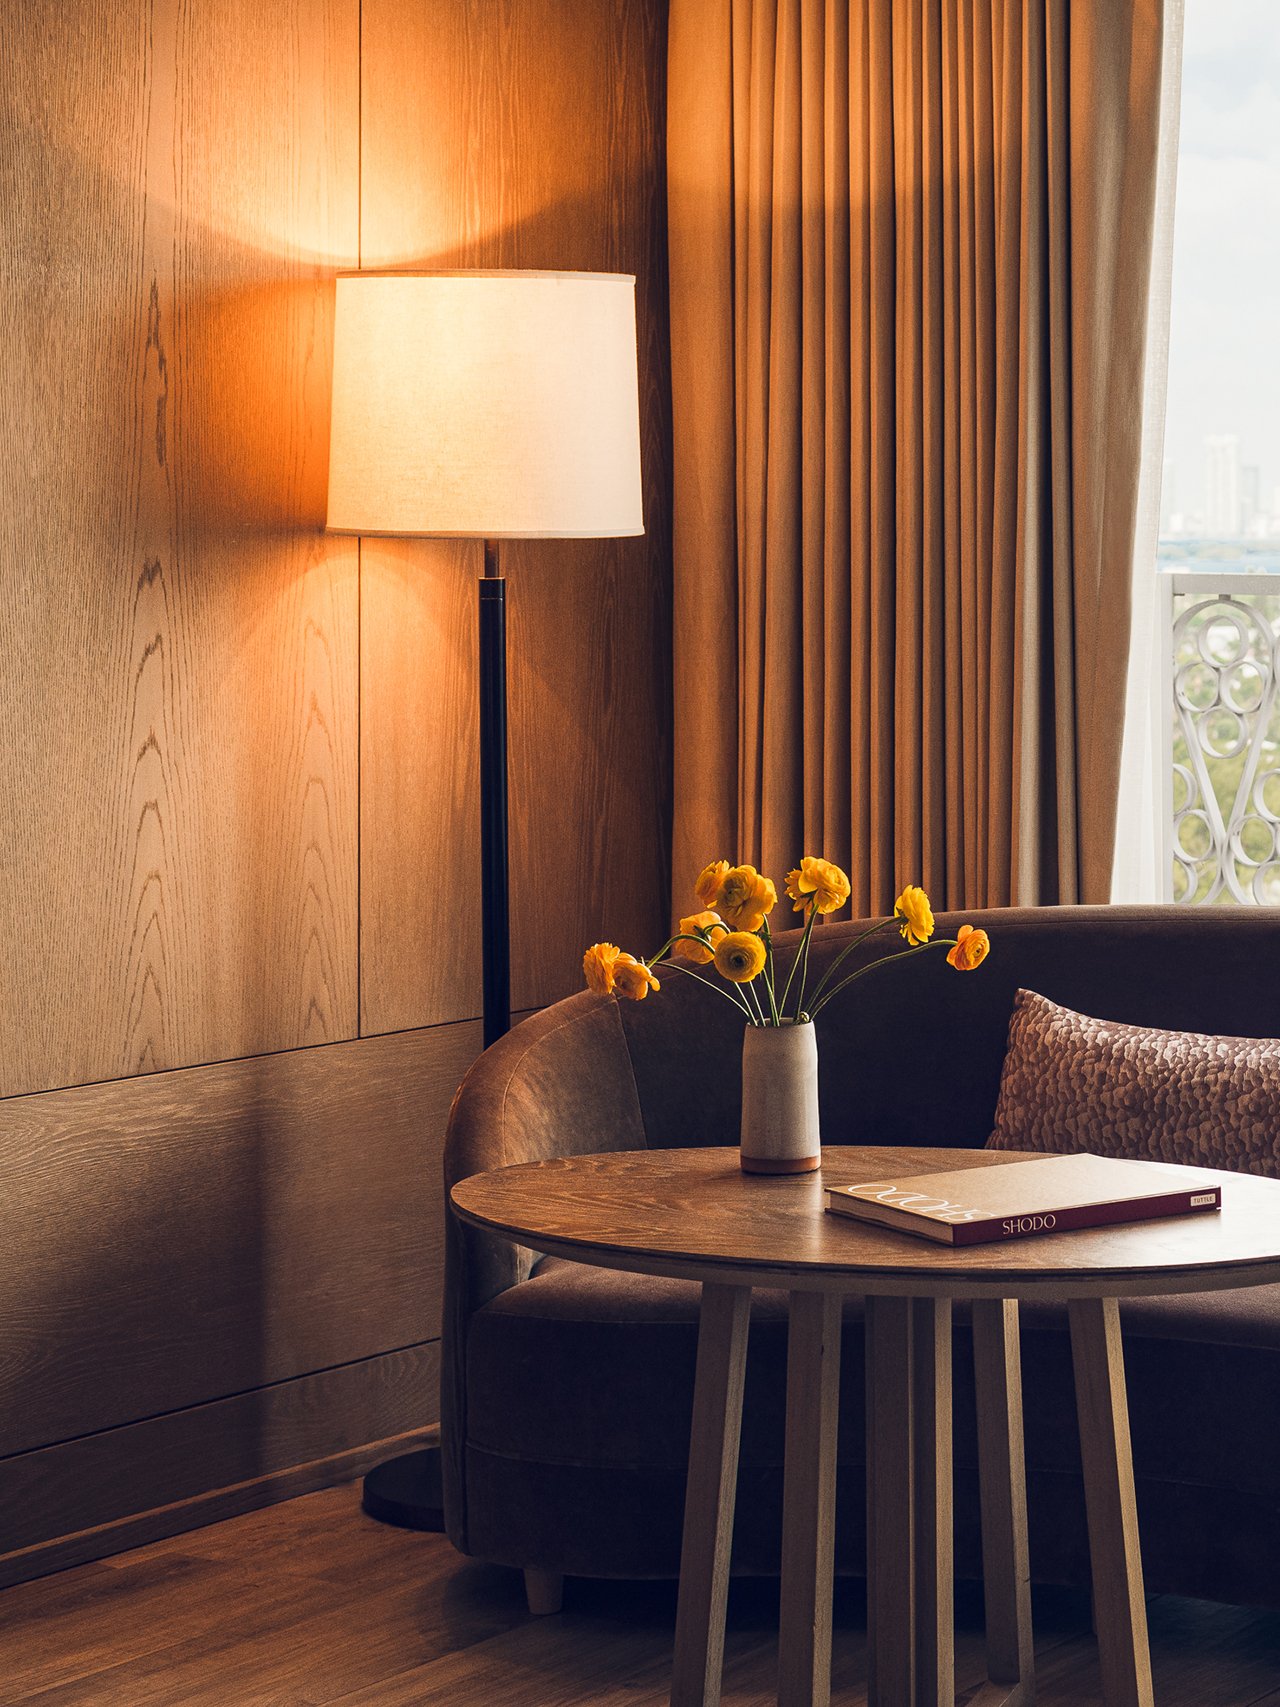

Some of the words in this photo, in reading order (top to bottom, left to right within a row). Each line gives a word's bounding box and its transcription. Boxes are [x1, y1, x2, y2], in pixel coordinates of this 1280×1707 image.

[847, 1183, 997, 1222] SHODO
[1193, 1195, 1213, 1204] TUTTLE
[1002, 1213, 1056, 1235] SHODO
